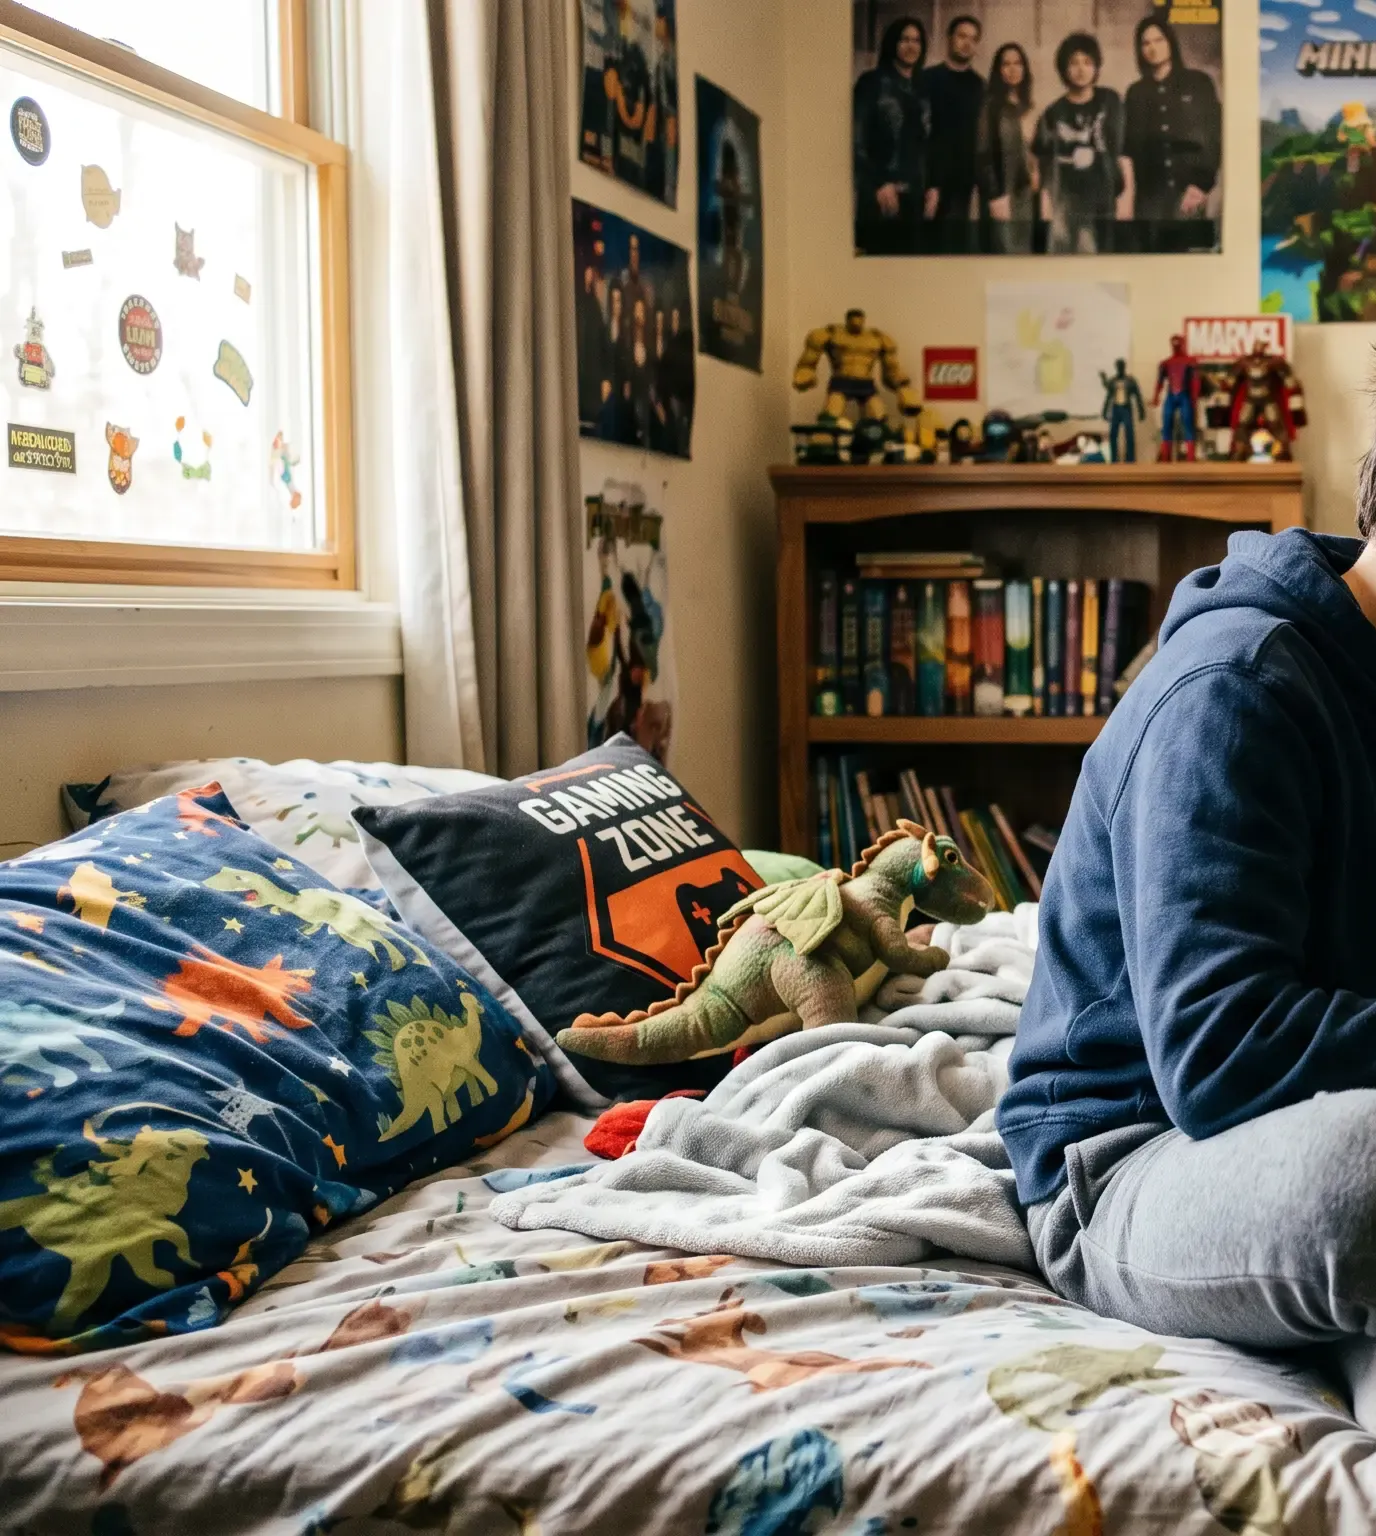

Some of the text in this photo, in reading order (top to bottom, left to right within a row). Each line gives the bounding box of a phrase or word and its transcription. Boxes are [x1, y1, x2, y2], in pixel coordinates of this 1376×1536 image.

[1188, 320, 1284, 356] MARVEL
[929, 364, 973, 386] LEGO
[518, 764, 682, 835] GAMING
[595, 805, 715, 873] ZONE
